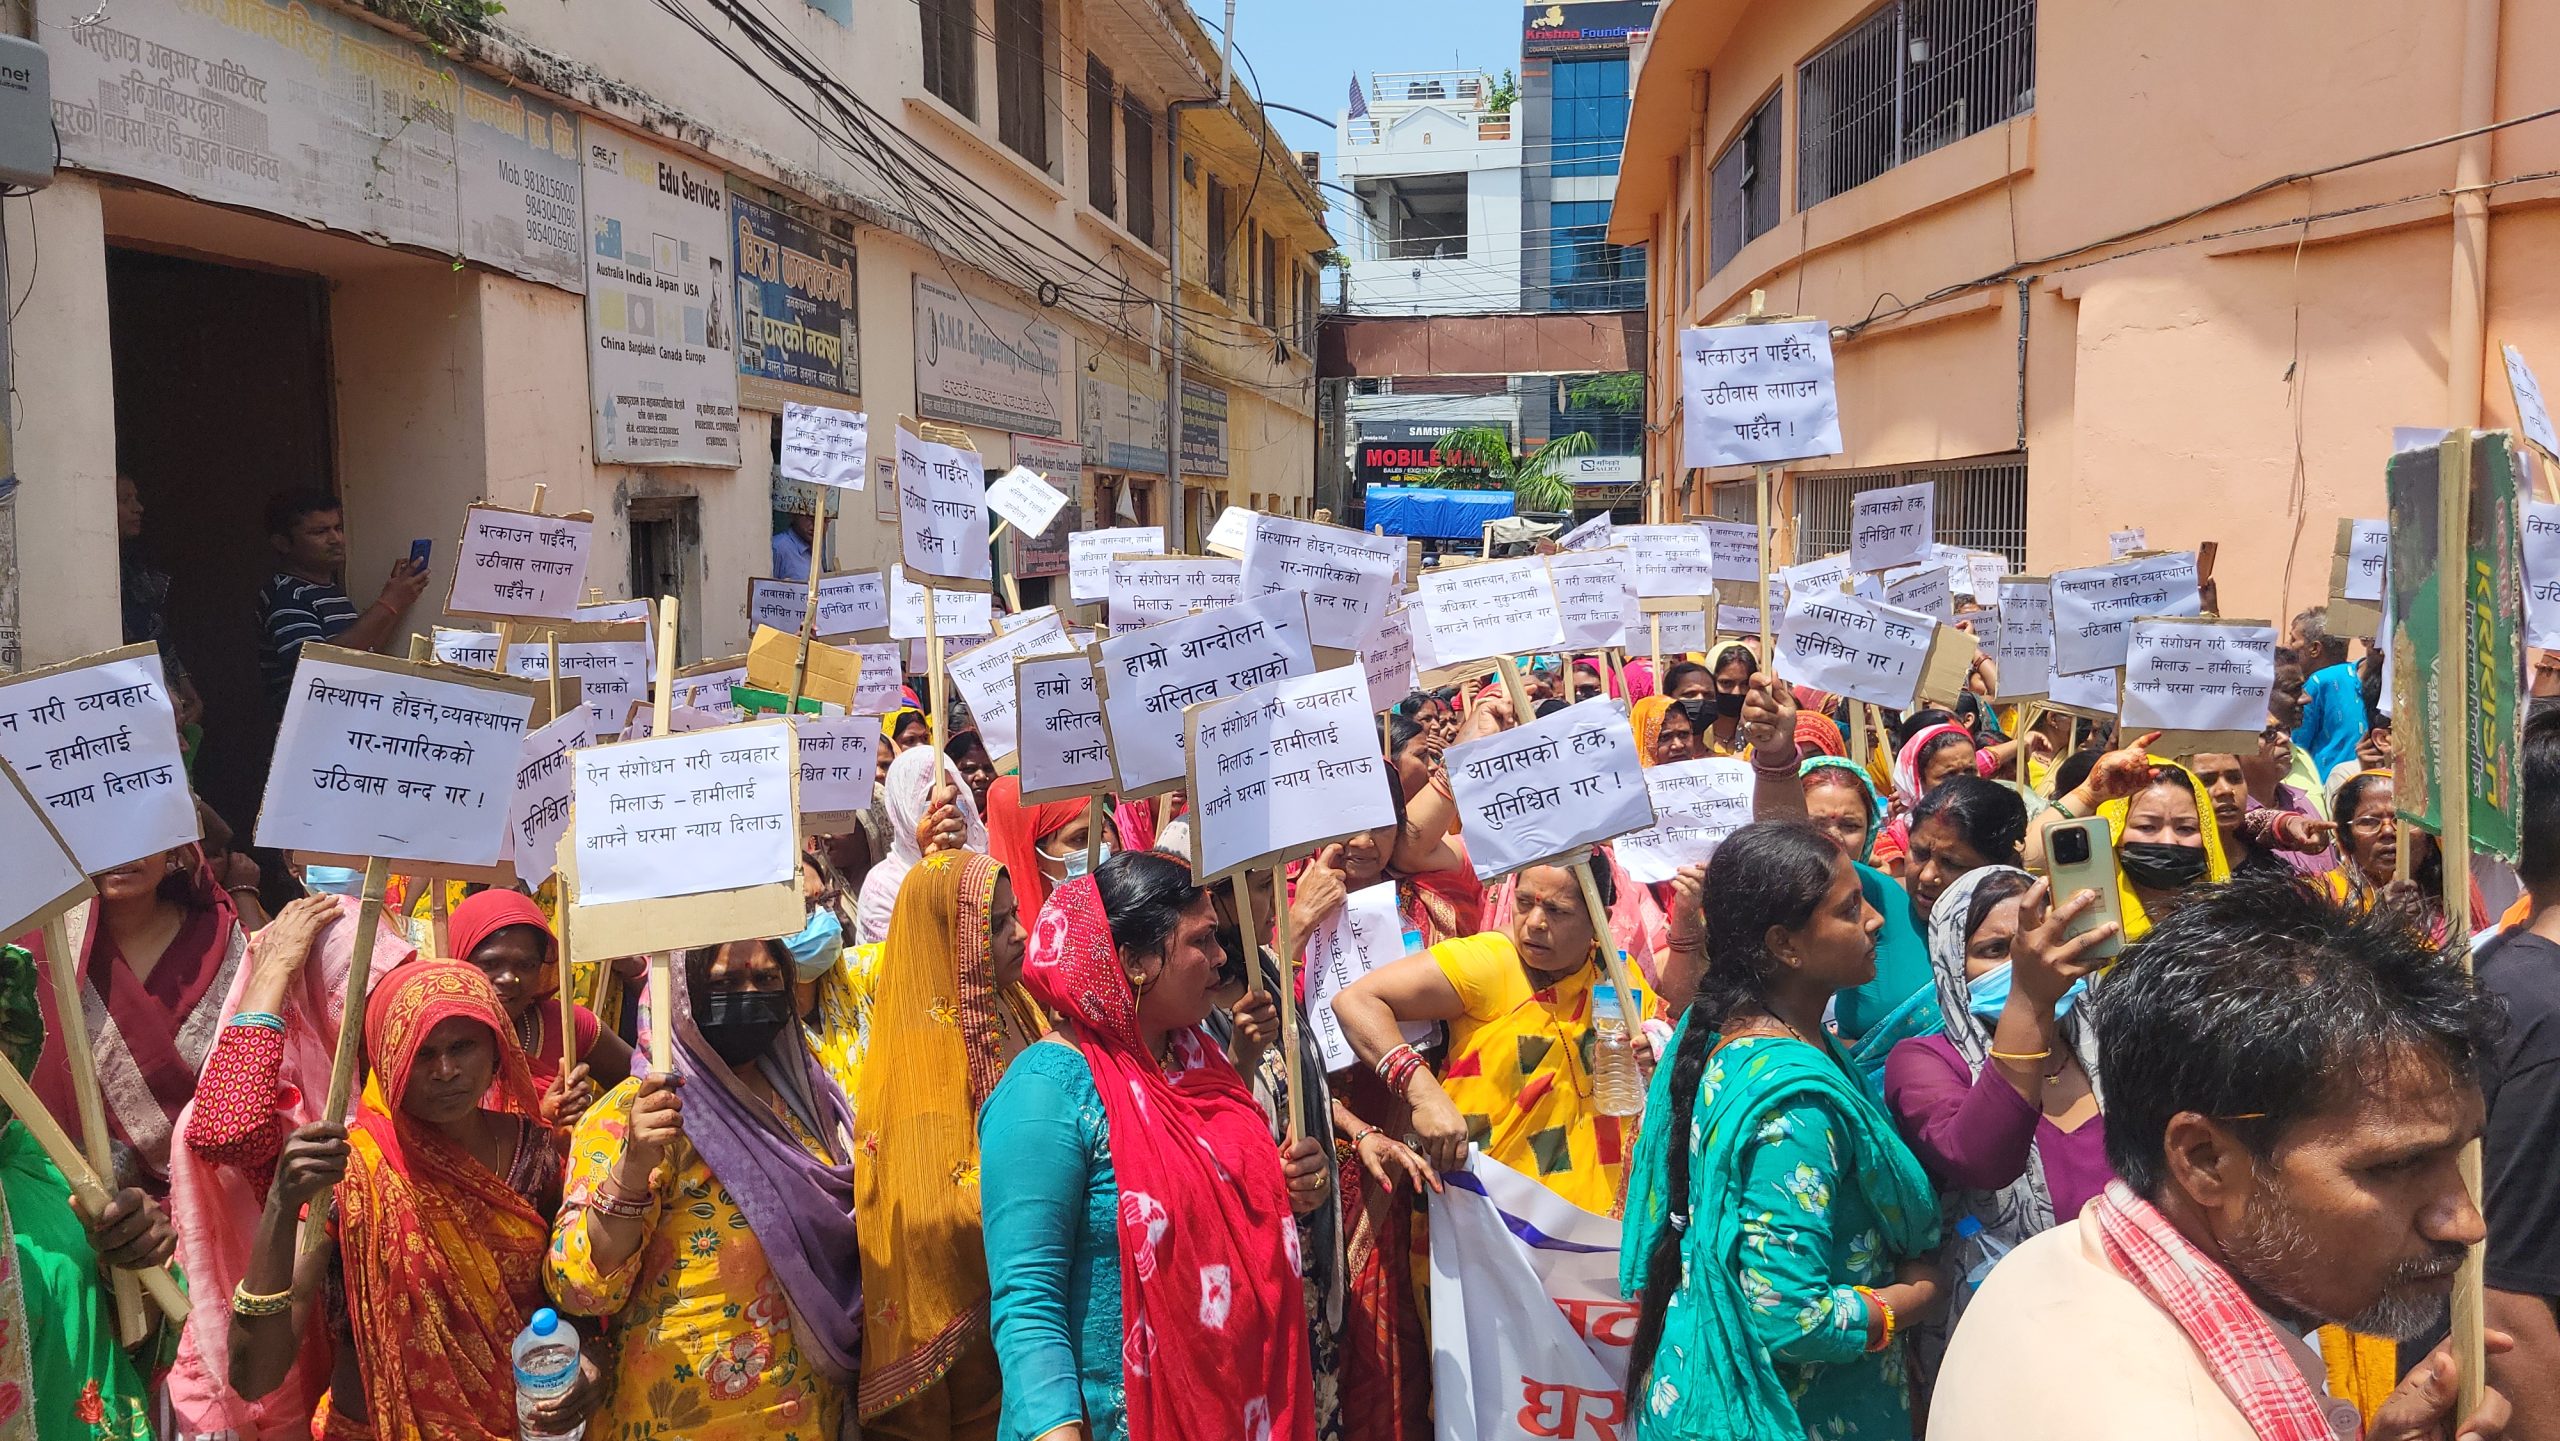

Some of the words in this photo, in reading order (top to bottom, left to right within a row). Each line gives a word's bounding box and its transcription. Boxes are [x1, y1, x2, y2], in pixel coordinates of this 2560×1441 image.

[1526, 28, 1581, 41] Krishna
[146, 40, 201, 84] अनुसार
[52, 99, 98, 136] घरको
[499, 159, 522, 188] Mob.
[524, 168, 575, 205] 9818156000
[658, 161, 679, 197] Edu
[681, 170, 721, 211] Service
[525, 194, 577, 230] 9843042098
[526, 219, 578, 254] 9854026903
[596, 262, 624, 280] Australia
[626, 269, 652, 287] India
[655, 276, 679, 293] Japan
[684, 282, 700, 298] USA
[600, 336, 625, 351] China
[629, 340, 656, 356] Bangladesh
[659, 346, 682, 361] Canada
[685, 349, 706, 365] Europe
[940, 311, 967, 352] S.N.R.
[969, 321, 1016, 376] Engineering
[1696, 347, 1759, 366] भत्काउन
[1765, 380, 1818, 400] लगाउन
[1733, 412, 1782, 441] पाइँदैन
[1366, 449, 1442, 468] MOBILE
[932, 500, 977, 521] लगाउन
[1860, 496, 1903, 516] आवासको
[479, 523, 533, 544] भत्काउन
[1256, 526, 1301, 547] विस्थापन
[1859, 525, 1896, 548] सुनिश्चित
[1900, 524, 1913, 537] गर
[531, 558, 574, 577] लगाउन
[1116, 570, 1131, 588] ऐन
[1139, 569, 1180, 586] संशोधन
[1187, 567, 1205, 585] गरी
[1279, 560, 1361, 585] गर-नागरिकको
[1435, 577, 1457, 592] हाम्रो
[1509, 567, 1532, 583] हाम्रो
[1670, 563, 1692, 574] खारेज
[493, 579, 535, 601] पाइँदैन
[759, 585, 795, 600] आवासको
[819, 580, 855, 597] आवासको
[2061, 579, 2106, 594] विस्थापन
[759, 605, 791, 621] सुनिश्चित
[820, 603, 853, 619] सुनिश्चित
[858, 601, 872, 612] गर
[1133, 595, 1174, 612] मिलाऊ
[1314, 592, 1336, 608] बन्द
[1342, 598, 1359, 613] गर
[1439, 598, 1478, 614] अधिकार
[2090, 588, 2168, 613] गर-नागरिकको
[1473, 609, 1500, 629] निर्णय
[1505, 605, 1532, 624] खारेज
[1539, 607, 1553, 617] गर
[1803, 601, 1877, 634] आवासको
[1123, 643, 1169, 678] हाम्रो
[1180, 618, 1266, 661] आन्दोलन
[1796, 633, 1859, 664] सुनिश्चित
[1867, 652, 1891, 673] गर
[2135, 634, 2153, 648] ऐन
[2159, 633, 2202, 650] संशोधन
[2206, 633, 2225, 650] गरी
[2230, 640, 2270, 652] व्यवहार
[520, 652, 550, 670] हाम्रो
[559, 652, 618, 669] आन्दोलन
[957, 668, 976, 685] ऐन
[977, 649, 1012, 675] संशोधन
[1012, 645, 1029, 664] गरी
[1028, 628, 1060, 650] व्यवहार
[2151, 657, 2191, 673] मिलाऊ
[2208, 658, 2253, 675] हामीलाई
[307, 678, 384, 711] विस्थापन
[585, 677, 629, 695] रक्षाको
[867, 682, 886, 693] खारेज
[1034, 672, 1070, 698] हाम्रो
[1145, 679, 1218, 714] अस्तित्व
[1226, 652, 1289, 692] रक्षाको
[2132, 680, 2161, 693] आफ्नै
[2167, 684, 2193, 695] घरमा
[2200, 684, 2225, 696] न्याय
[2231, 682, 2267, 698] दिलाऊ
[29, 696, 66, 725] गरी
[74, 682, 157, 712] व्यवहार
[981, 698, 1007, 723] आफ्नै
[1045, 709, 1101, 732] अस्तित्व
[1201, 724, 1217, 748] ऐन
[1221, 710, 1258, 738] संशोधन
[1262, 697, 1286, 721] गरी
[1293, 686, 1360, 710] व्यवहार
[45, 724, 132, 770] हामीलाई
[347, 730, 475, 766] गर-नागरिकको
[841, 734, 867, 753] हक,
[1217, 747, 1255, 776] मिलाऊ
[1270, 721, 1339, 756] हामीलाई
[1466, 736, 1559, 780] आवासको
[1568, 728, 1616, 755] हक,
[2467, 695, 2483, 799] Noodles
[516, 739, 569, 792] आवासको
[586, 763, 610, 787] ऐन
[618, 754, 675, 780] संशोधन
[684, 749, 712, 771] गरी
[720, 745, 780, 766] व्यवहार
[832, 766, 851, 781] गर
[1716, 769, 1743, 785] हाम्रो
[46, 784, 95, 809] न्याय
[104, 764, 173, 798] दिलाऊ
[397, 778, 436, 802] बन्द
[445, 785, 470, 807] गर
[609, 792, 666, 815] मिलाऊ
[691, 780, 758, 805] हामीलाई
[1205, 786, 1232, 817] आफ्नै
[1236, 780, 1266, 804] घरमा
[1271, 769, 1310, 789] न्याय
[1317, 756, 1373, 781] दिलाऊ
[1479, 786, 1560, 830] सुनिश्चित
[1570, 774, 1604, 798] गर
[586, 824, 628, 851] आफ्नै
[636, 824, 676, 844] घरमा
[686, 820, 722, 840] न्याय
[730, 812, 783, 837] दिलाऊ
[1667, 825, 1698, 843] निर्णय
[1319, 1006, 1342, 1059] विस्थापन
